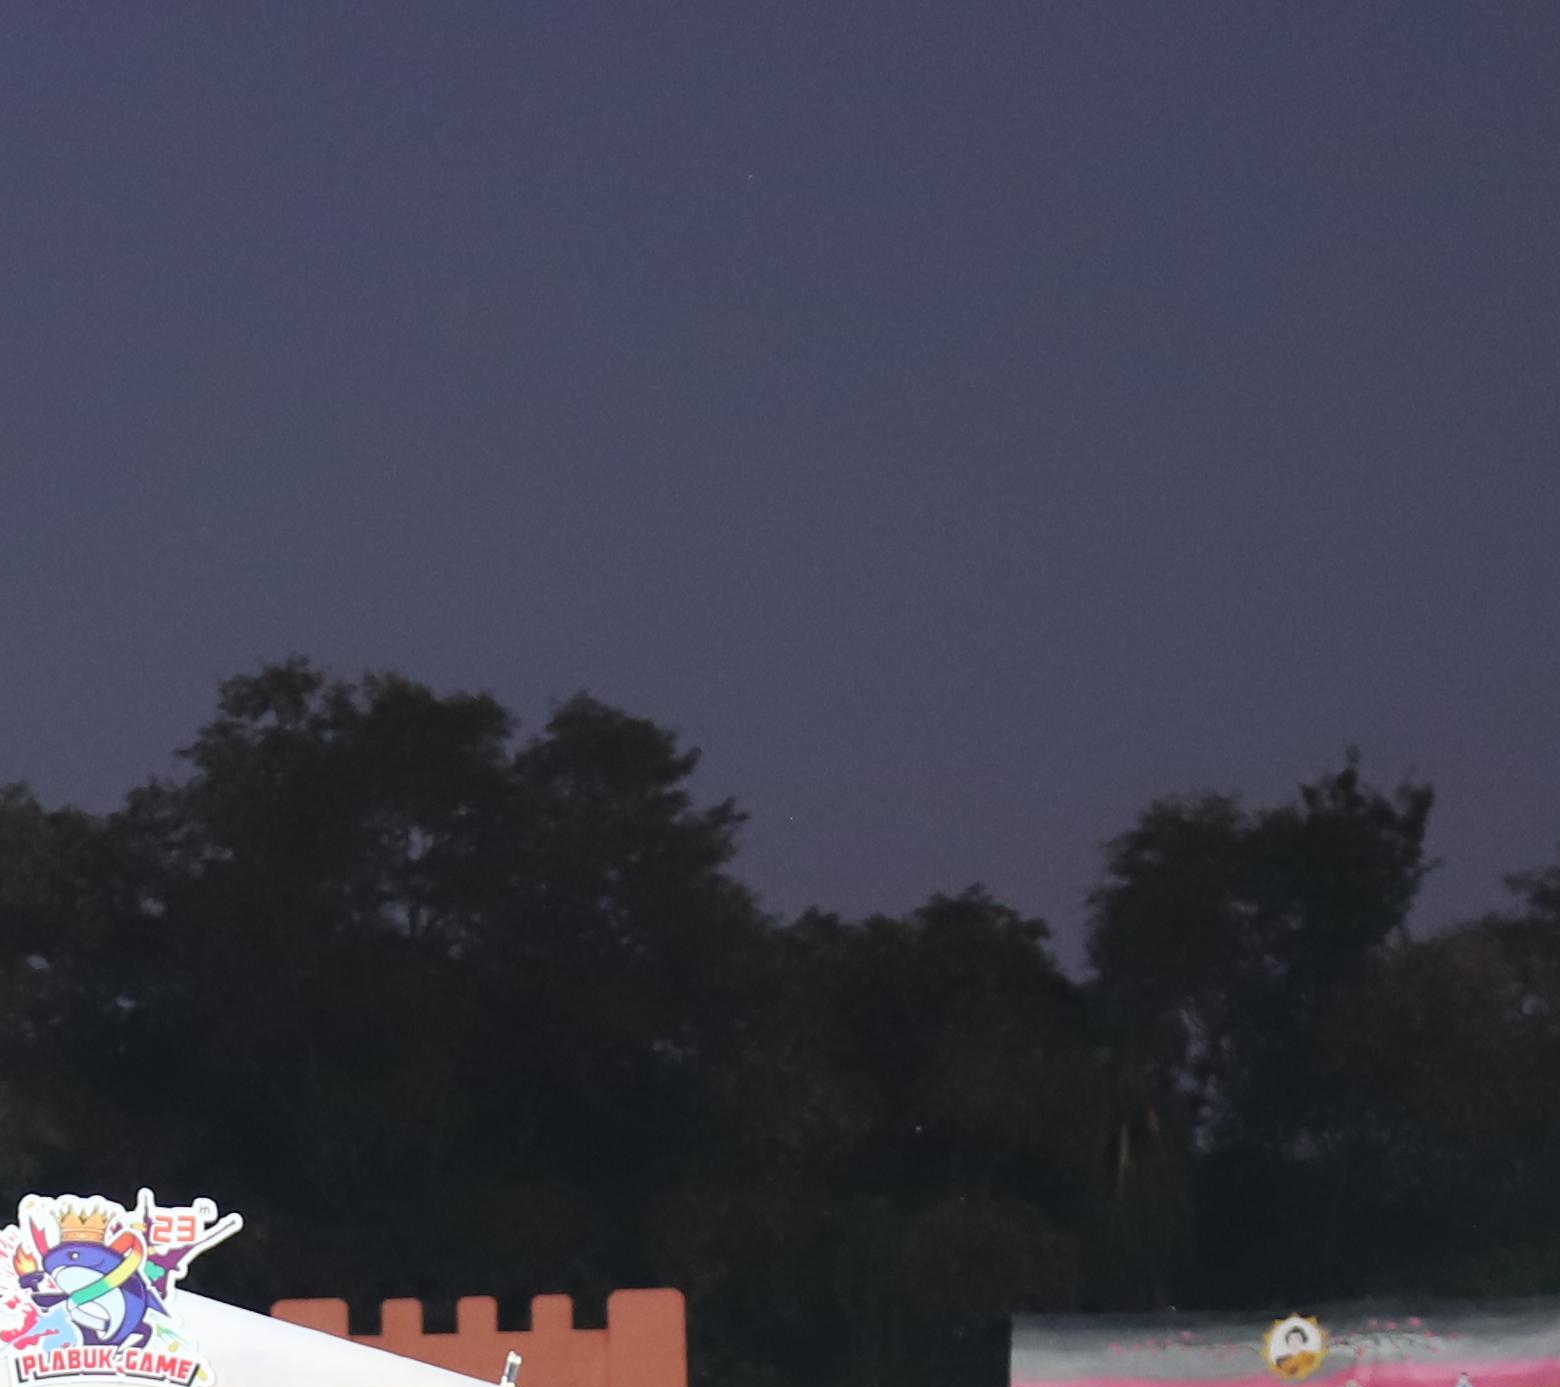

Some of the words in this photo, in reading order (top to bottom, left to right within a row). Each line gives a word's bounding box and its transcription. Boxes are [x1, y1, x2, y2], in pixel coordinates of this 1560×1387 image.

[152, 1215, 197, 1243] 23
[22, 1349, 114, 1376] PLABUK
[125, 1350, 195, 1380] GAME
